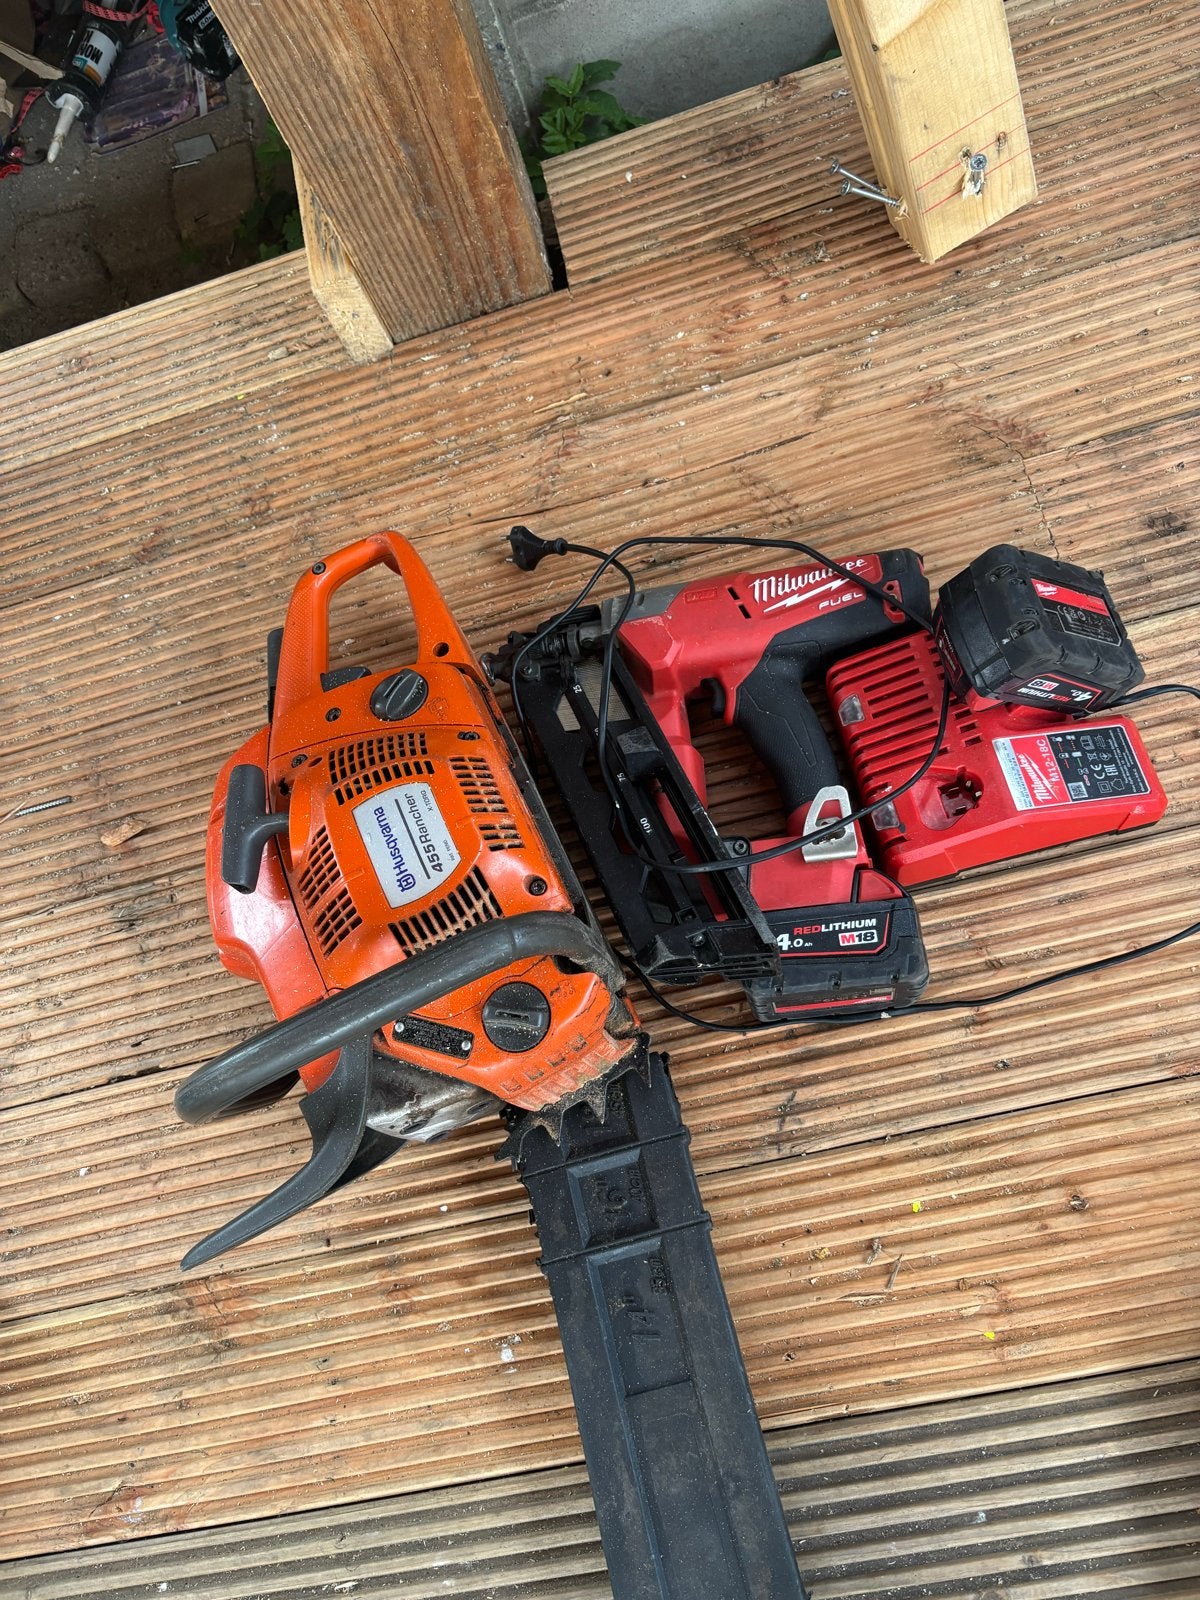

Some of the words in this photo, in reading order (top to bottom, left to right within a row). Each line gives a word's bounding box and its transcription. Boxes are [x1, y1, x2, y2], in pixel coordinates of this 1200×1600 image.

[748, 558, 868, 604] Milwauee
[818, 591, 863, 610] FUEL
[573, 684, 582, 694] 25
[1029, 679, 1057, 690] M18
[1036, 739, 1061, 781] M12-18C
[616, 772, 626, 782] 75
[1016, 753, 1052, 803] Milwaukee
[405, 793, 431, 844] Rancher
[640, 817, 651, 833] 100
[374, 806, 408, 877] Husqvarna
[423, 843, 443, 872] 455
[793, 918, 877, 935] REDLITHIUM
[777, 934, 804, 950] 4.0
[840, 931, 876, 945] M18
